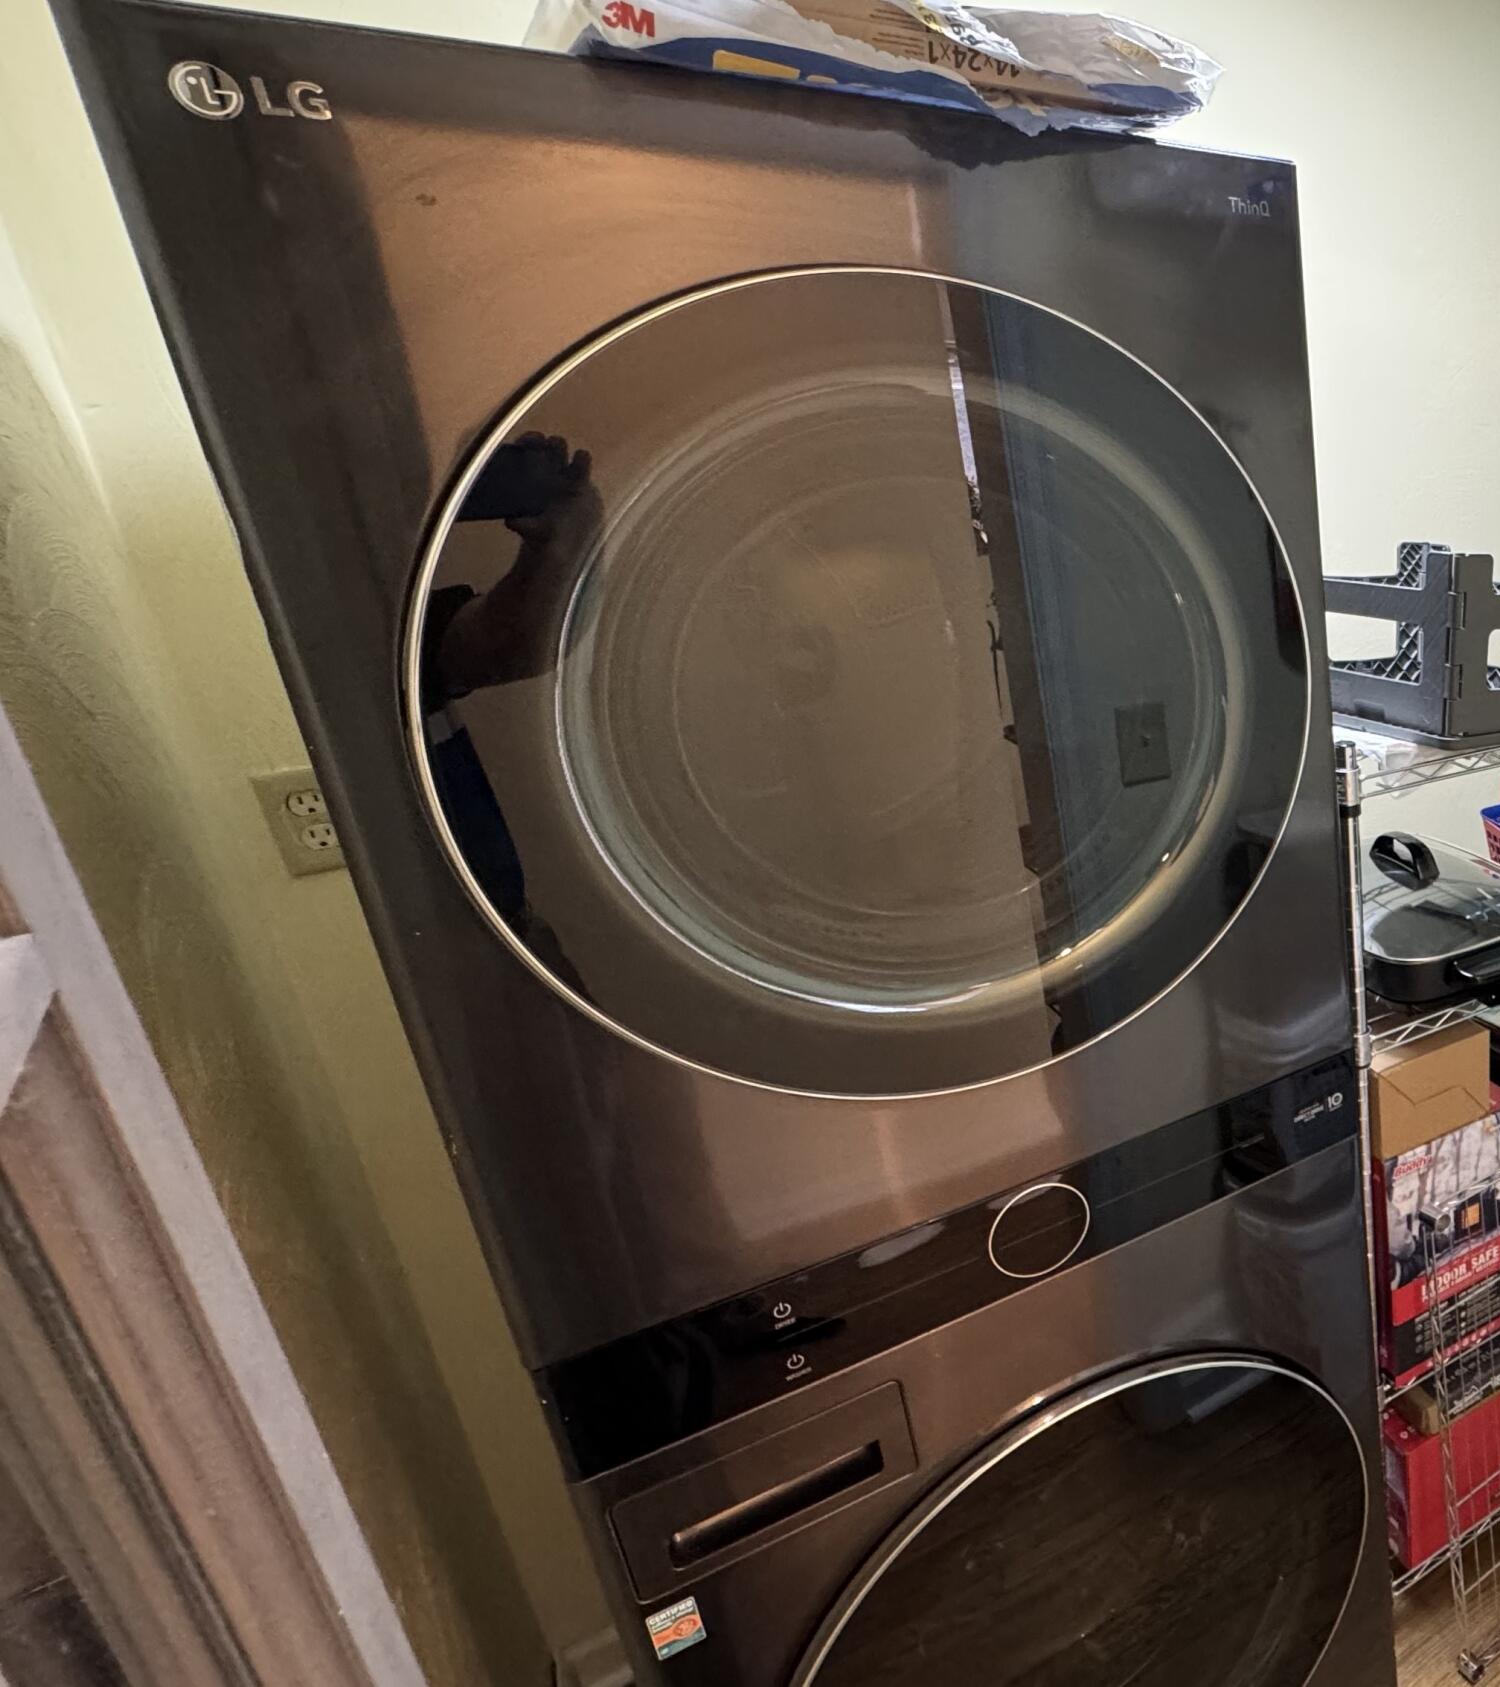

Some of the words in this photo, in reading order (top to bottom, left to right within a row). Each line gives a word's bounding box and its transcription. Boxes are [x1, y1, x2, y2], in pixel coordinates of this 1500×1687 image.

[601, 1, 655, 37] 3M
[249, 76, 332, 120] LG
[1227, 196, 1271, 217] ThinQ
[1471, 1246, 1500, 1267] SAFE
[649, 1599, 693, 1625] CERTIFIED
